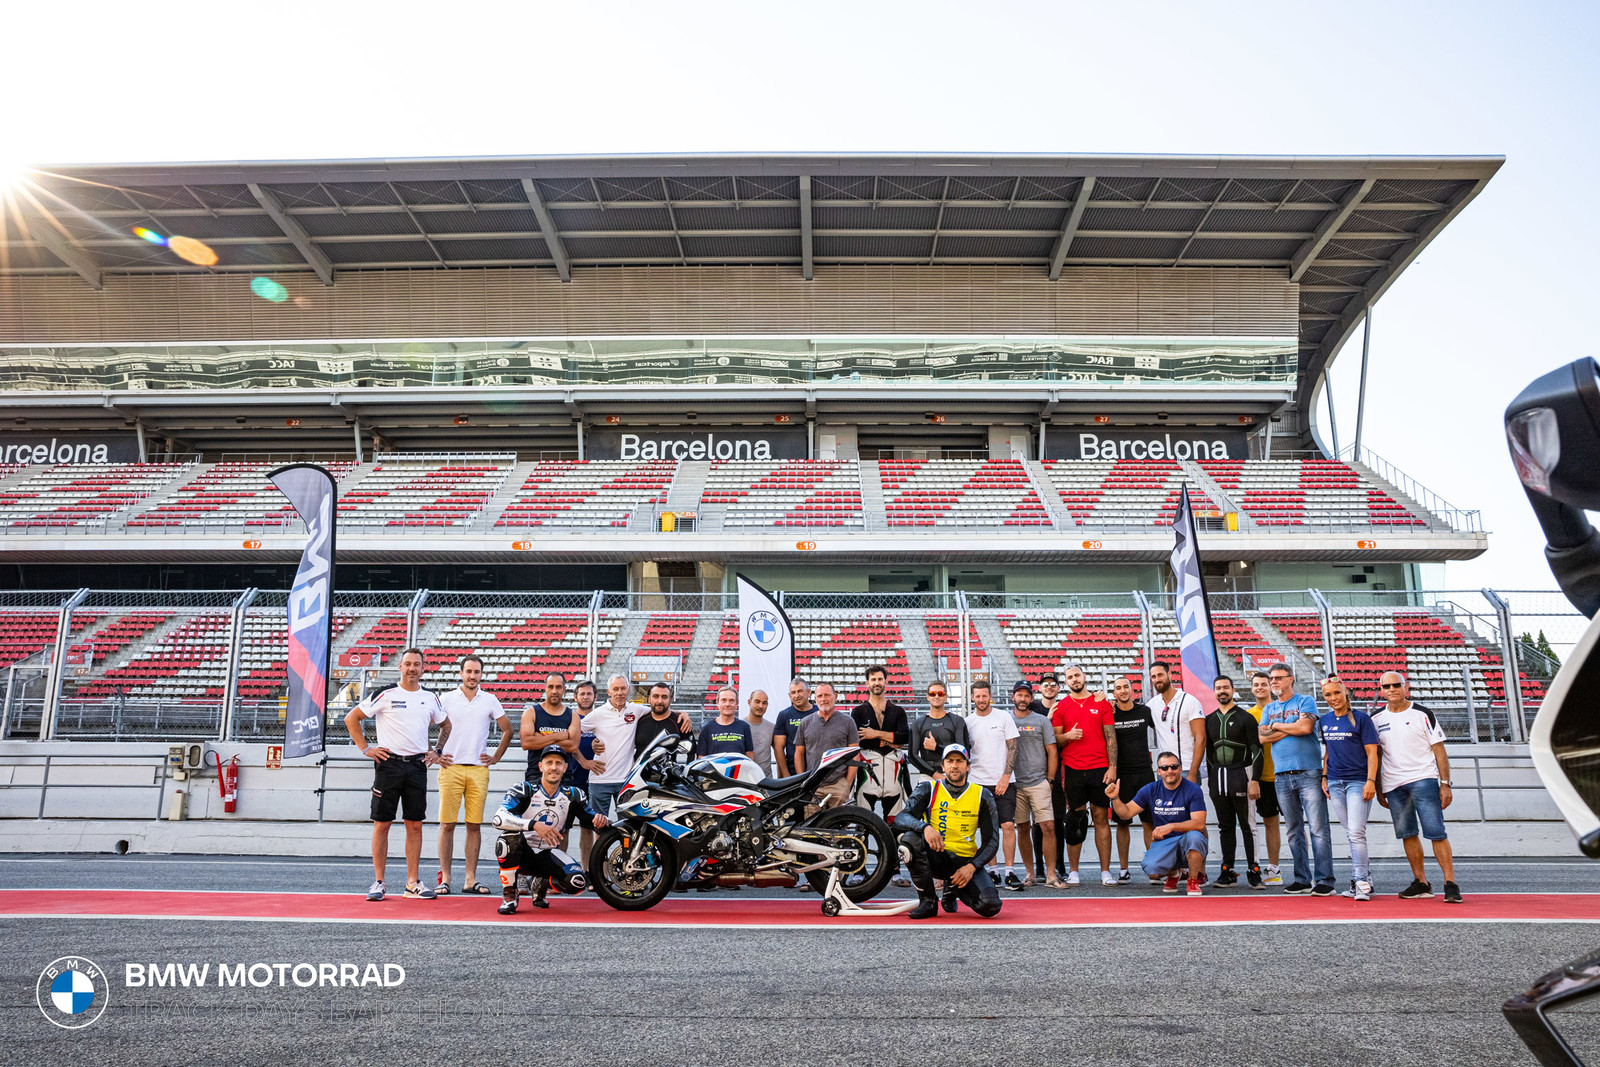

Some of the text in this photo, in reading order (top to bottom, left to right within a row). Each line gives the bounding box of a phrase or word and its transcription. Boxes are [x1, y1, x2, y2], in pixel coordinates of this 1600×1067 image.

[620, 433, 772, 460] Barcelona
[1079, 433, 1229, 460] Barcelona
[0, 438, 108, 464] rcelona
[250, 541, 260, 549] 17
[519, 542, 530, 550] 18
[804, 542, 815, 550] 19
[1089, 541, 1101, 549] 20
